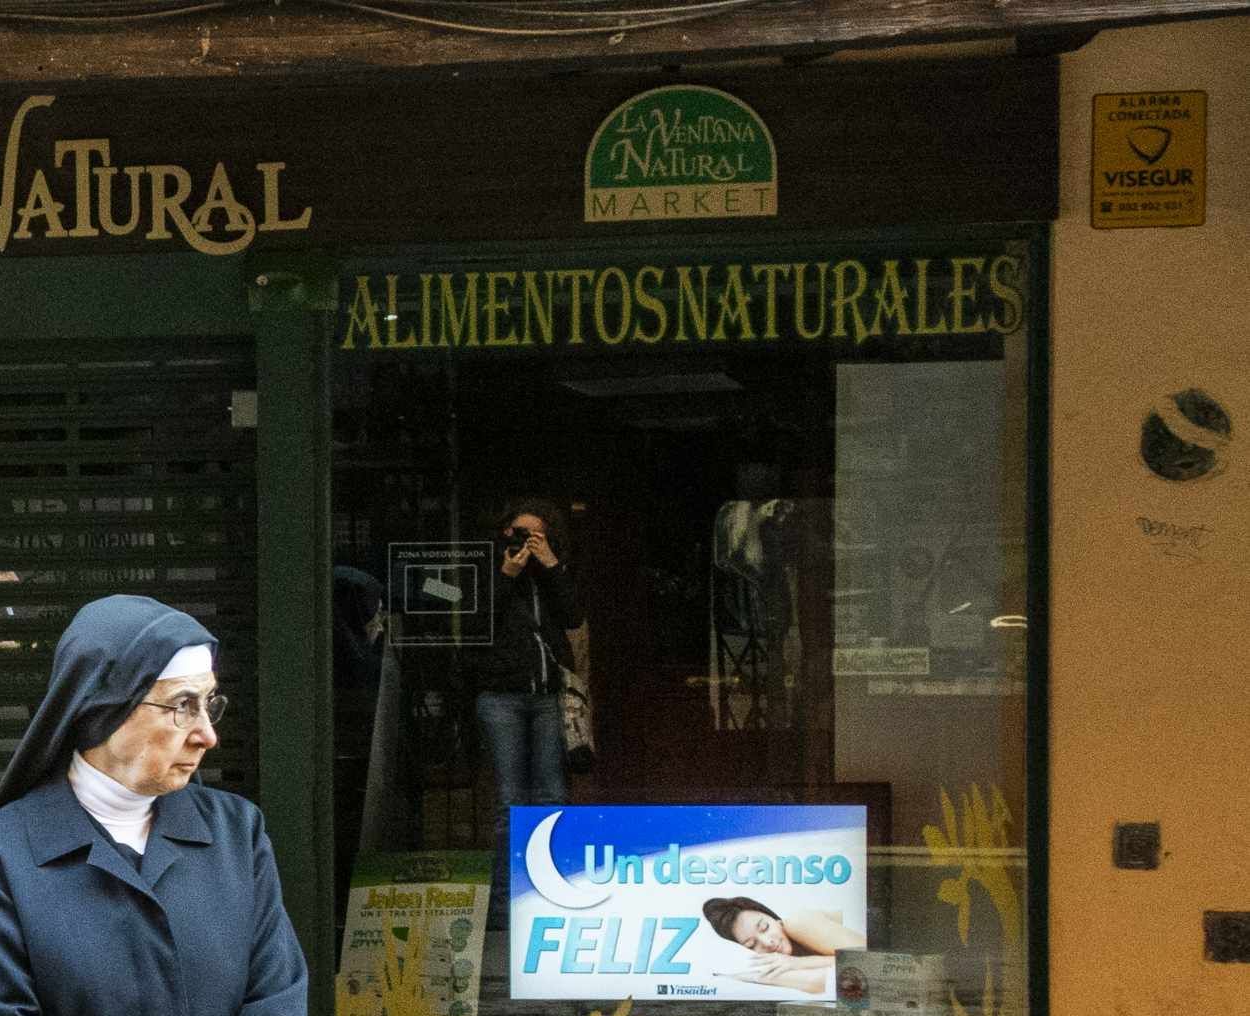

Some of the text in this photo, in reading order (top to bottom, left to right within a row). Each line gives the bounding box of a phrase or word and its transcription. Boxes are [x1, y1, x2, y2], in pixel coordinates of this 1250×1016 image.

[1108, 109, 1191, 121] CONECTADA
[1118, 95, 1182, 108] ALARMA
[615, 106, 756, 148] LA VENTANA
[609, 126, 754, 181] NATURAL
[1102, 167, 1195, 188] VISEGUR
[592, 187, 771, 217] MARKET
[341, 255, 1024, 349] ALIMENTOS NATURALES
[397, 551, 420, 559] ZONA
[584, 843, 854, 886] Un descanso
[523, 916, 701, 975] FELIZ
